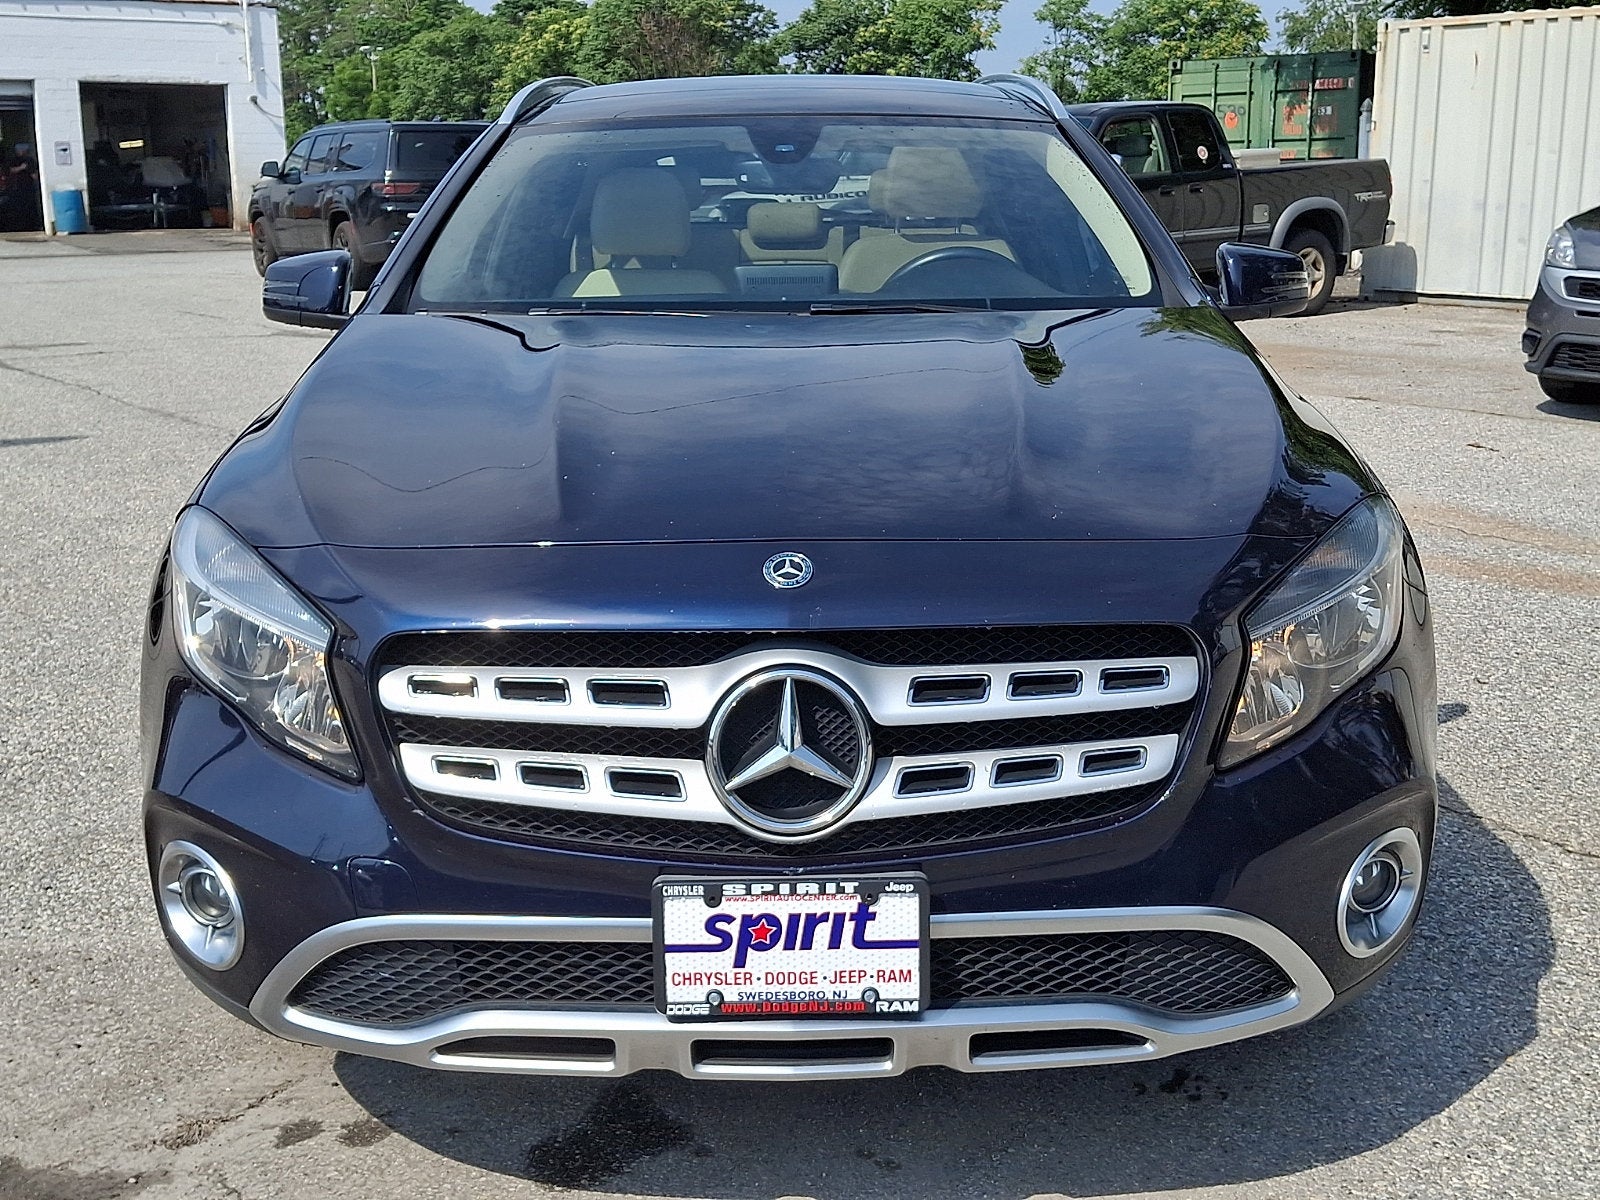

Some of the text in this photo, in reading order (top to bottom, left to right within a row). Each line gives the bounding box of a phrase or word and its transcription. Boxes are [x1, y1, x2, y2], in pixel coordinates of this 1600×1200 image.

[801, 190, 868, 201] RUBICO
[662, 885, 705, 896] CHRYSLER
[722, 882, 859, 895] SPIRIT
[885, 881, 914, 892] Jeep
[704, 902, 877, 968] spirit
[671, 969, 912, 986] CHRYSLER DODGE JEEP RAM
[737, 989, 848, 1001] SWEDESBORO, NJ
[667, 1004, 710, 1015] DODGE
[721, 1001, 866, 1014] www.DodgeNJ.com
[876, 1001, 919, 1012] RAM
